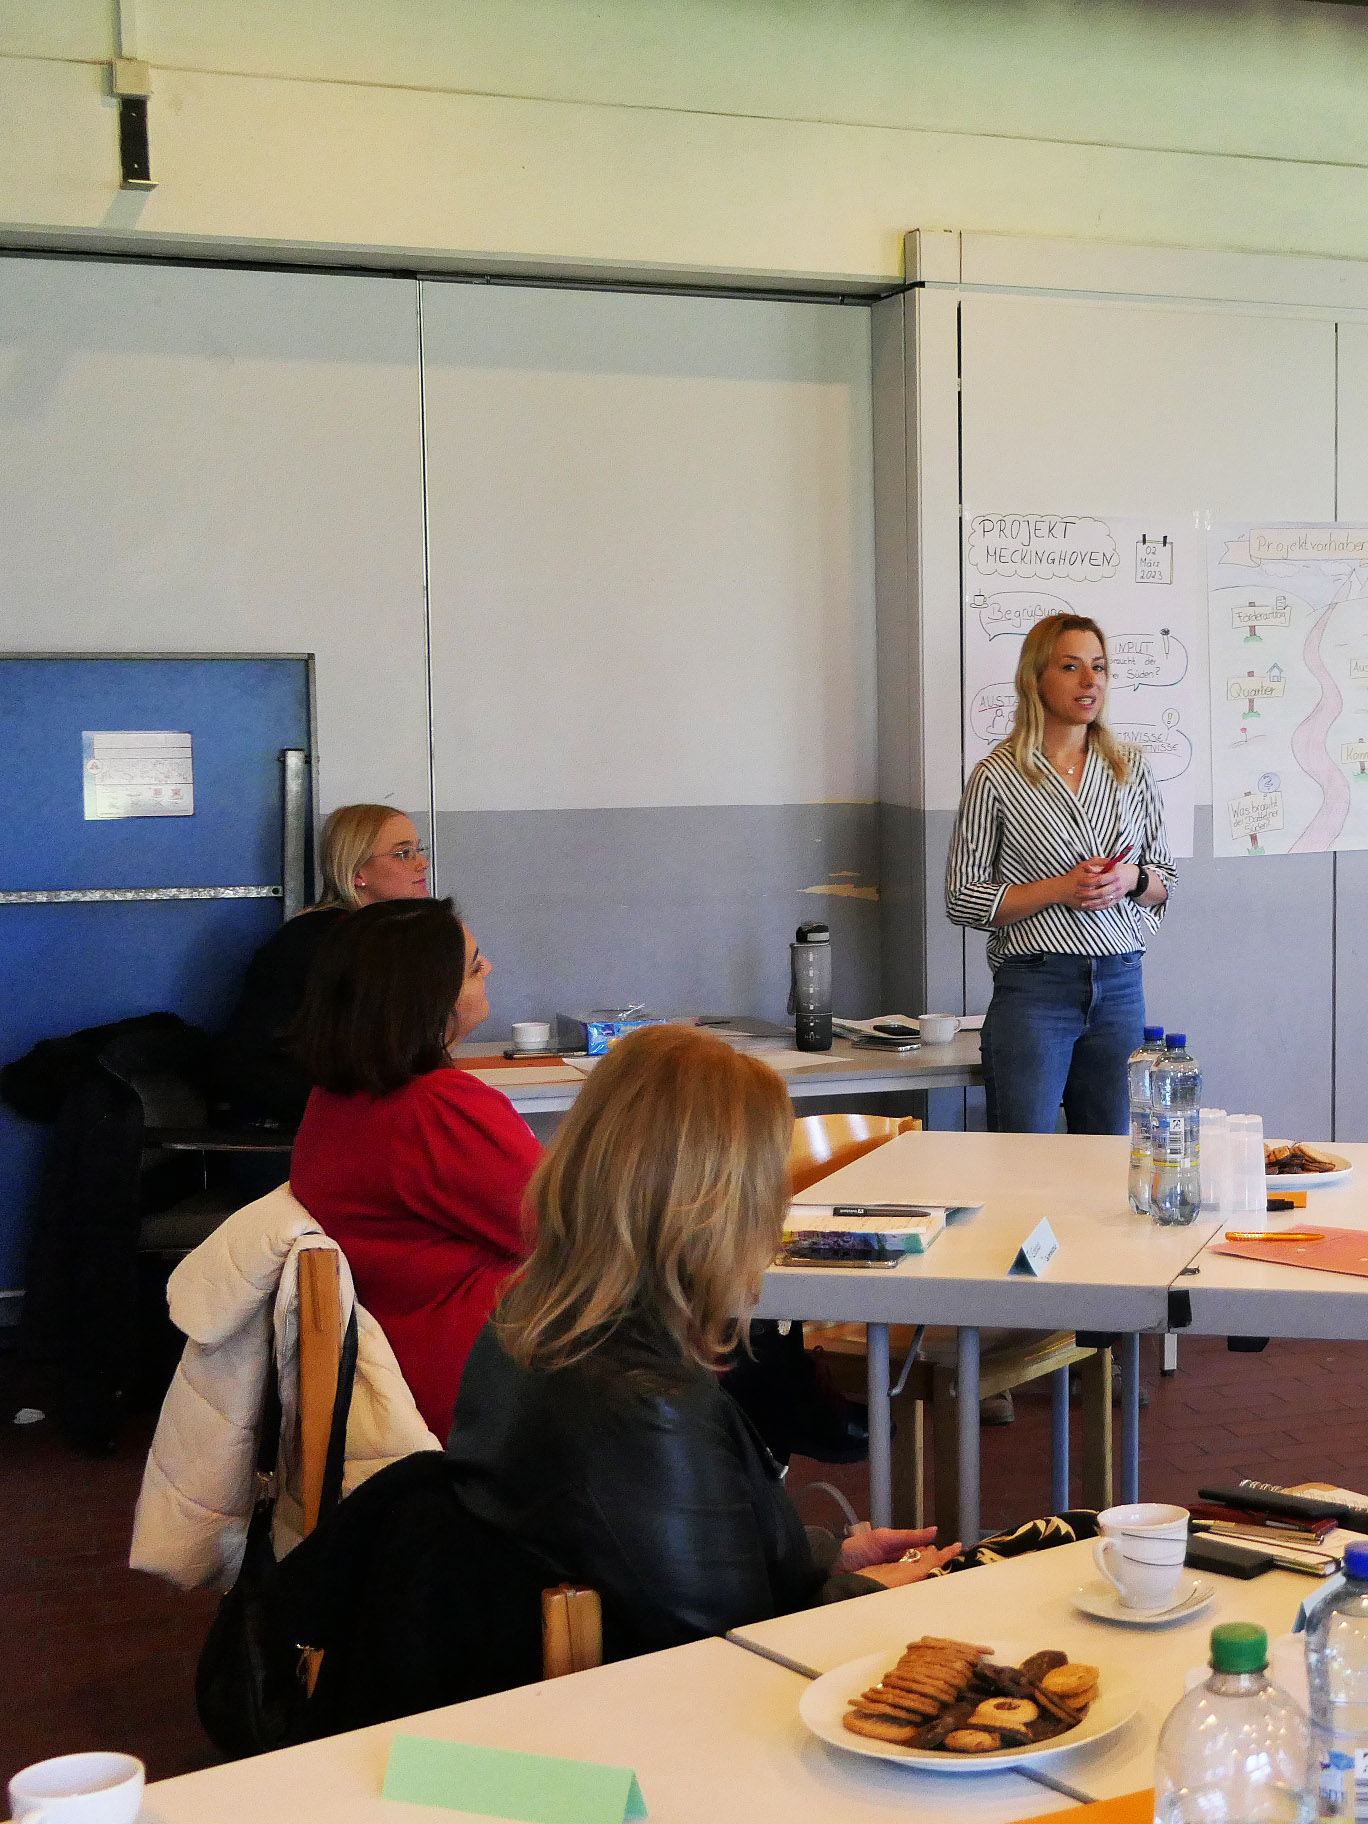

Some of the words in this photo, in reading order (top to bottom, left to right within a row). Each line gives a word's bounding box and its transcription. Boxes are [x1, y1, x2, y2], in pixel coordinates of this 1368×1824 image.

[979, 518, 1076, 546] PROJEKT
[986, 545, 1115, 567] MECKINGHOVEN
[1145, 545, 1157, 555] 02
[1139, 557, 1161, 568] März
[1139, 569, 1163, 581] 2023
[1114, 641, 1154, 654] INPUT
[1144, 656, 1157, 665] der
[1126, 666, 1161, 680] Süden?
[1230, 801, 1251, 819] Was
